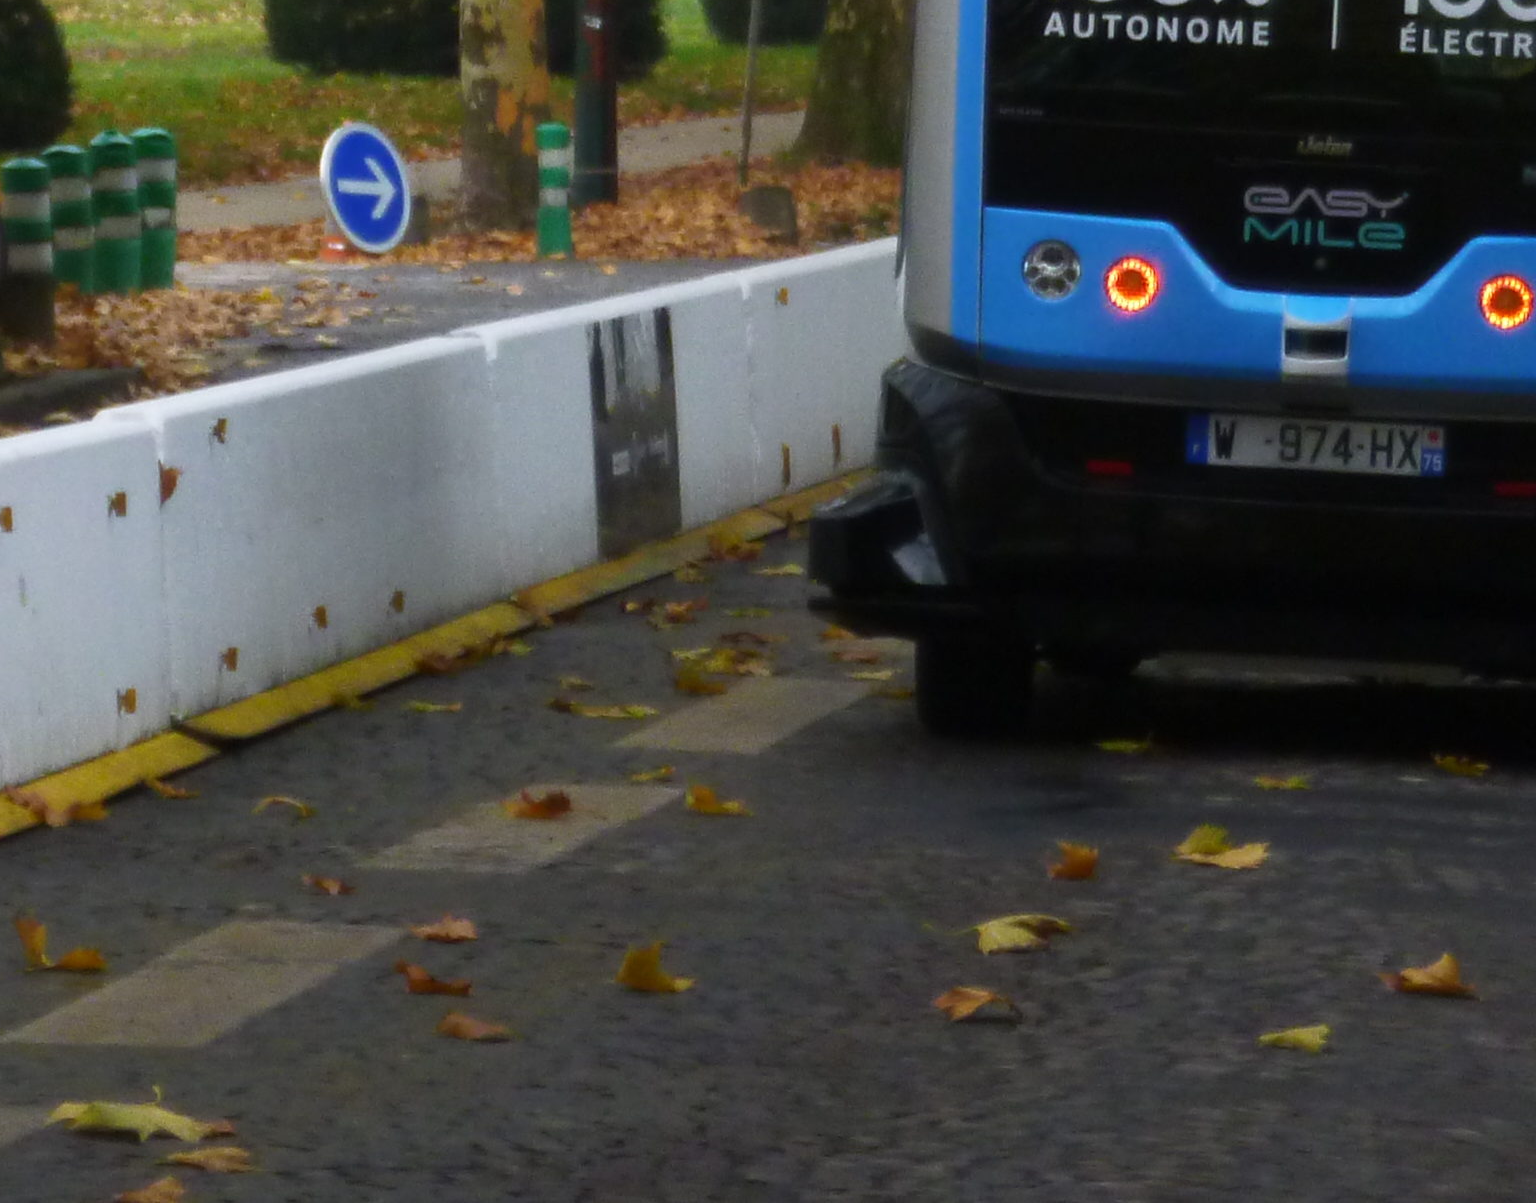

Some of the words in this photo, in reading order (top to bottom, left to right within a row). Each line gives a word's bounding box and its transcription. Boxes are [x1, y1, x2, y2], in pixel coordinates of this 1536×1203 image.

[1043, 11, 1272, 48] AUTONOME
[1213, 420, 1238, 460] W
[1422, 452, 1444, 473] 75
